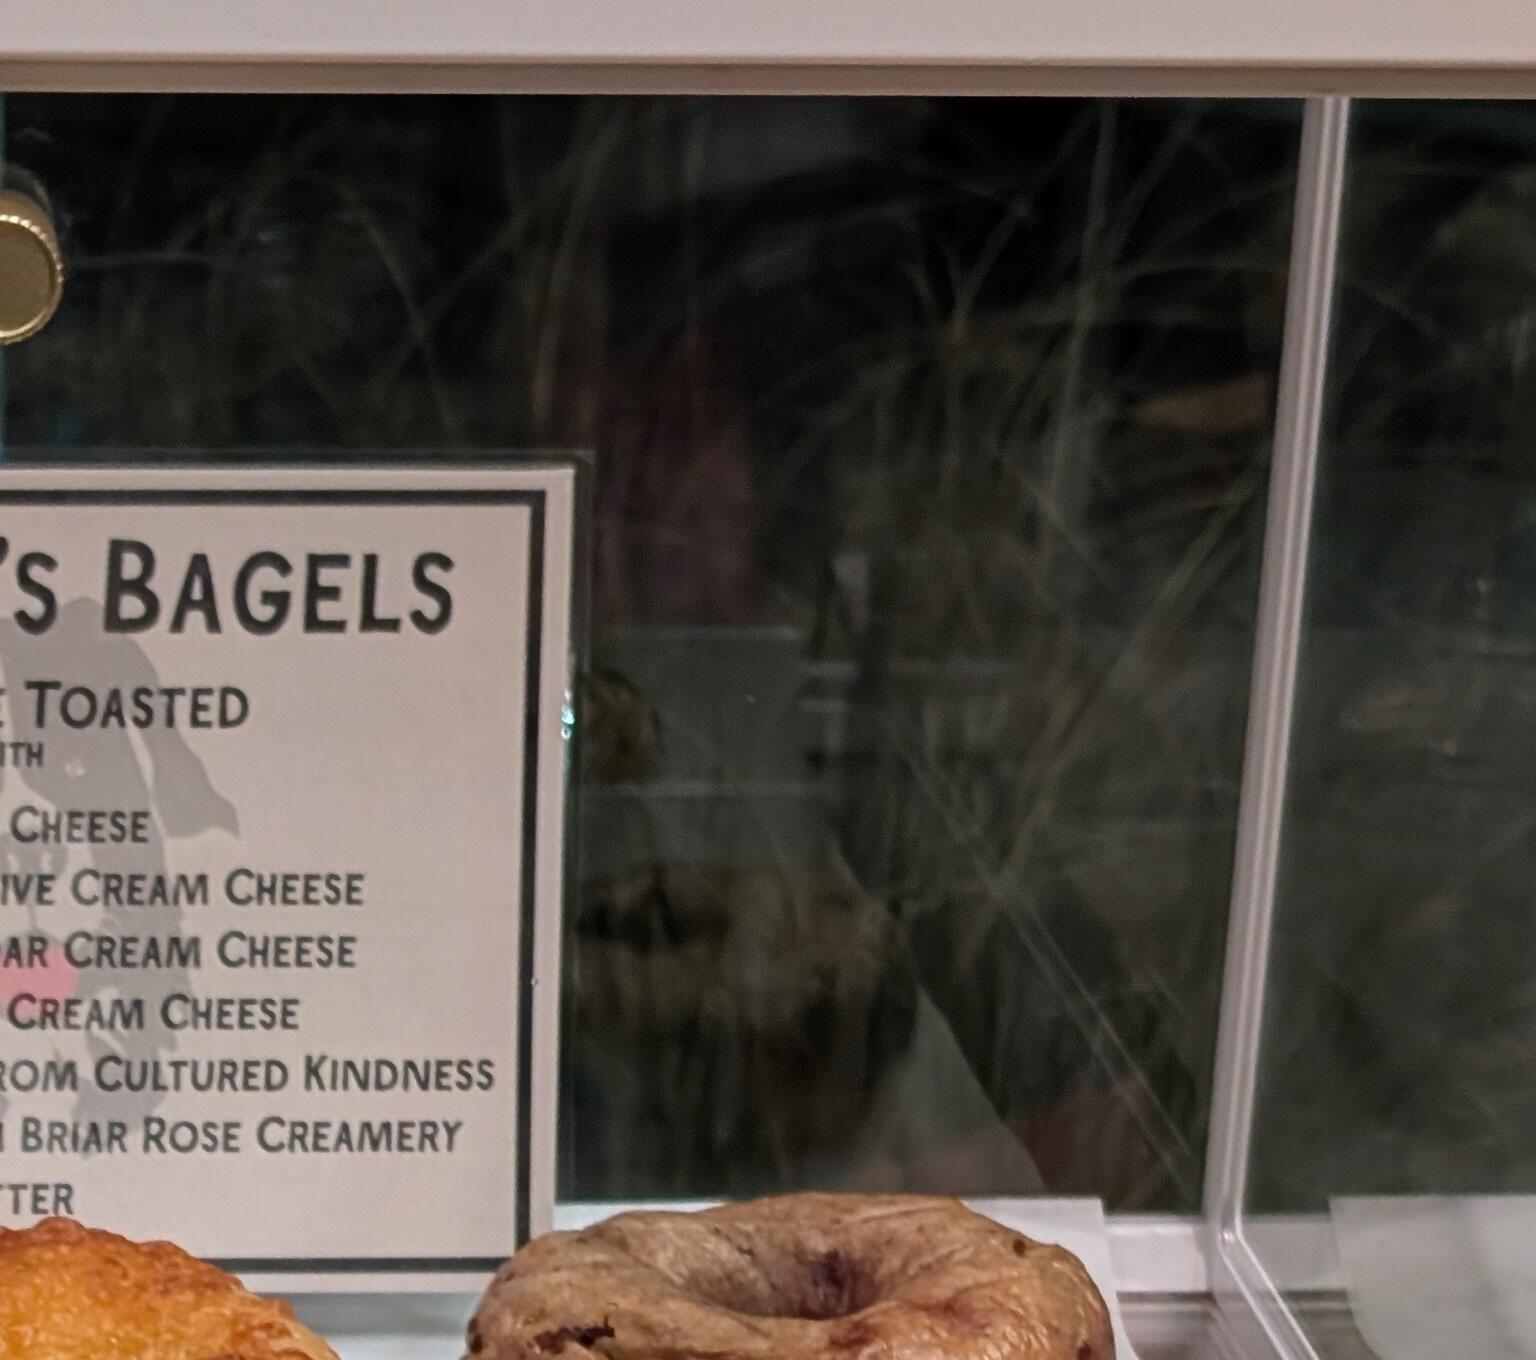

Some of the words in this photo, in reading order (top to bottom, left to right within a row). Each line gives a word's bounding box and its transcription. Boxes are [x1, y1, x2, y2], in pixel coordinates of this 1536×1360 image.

[105, 539, 455, 635] BAGELS
[26, 681, 250, 729] TOASTED
[10, 806, 149, 845] CHEESE
[71, 867, 210, 907] CREAM
[226, 867, 363, 907] CHEESE
[66, 929, 201, 971] CREAM
[218, 929, 356, 971] CHEESE
[8, 993, 145, 1031] CREAM
[161, 993, 299, 1031] CHEESE
[94, 1054, 288, 1093] CULTURED
[305, 1054, 494, 1093] KINDNESS
[19, 1115, 127, 1154] BRIAR
[143, 1115, 239, 1154] ROSE
[256, 1115, 463, 1154] CREAMERY
